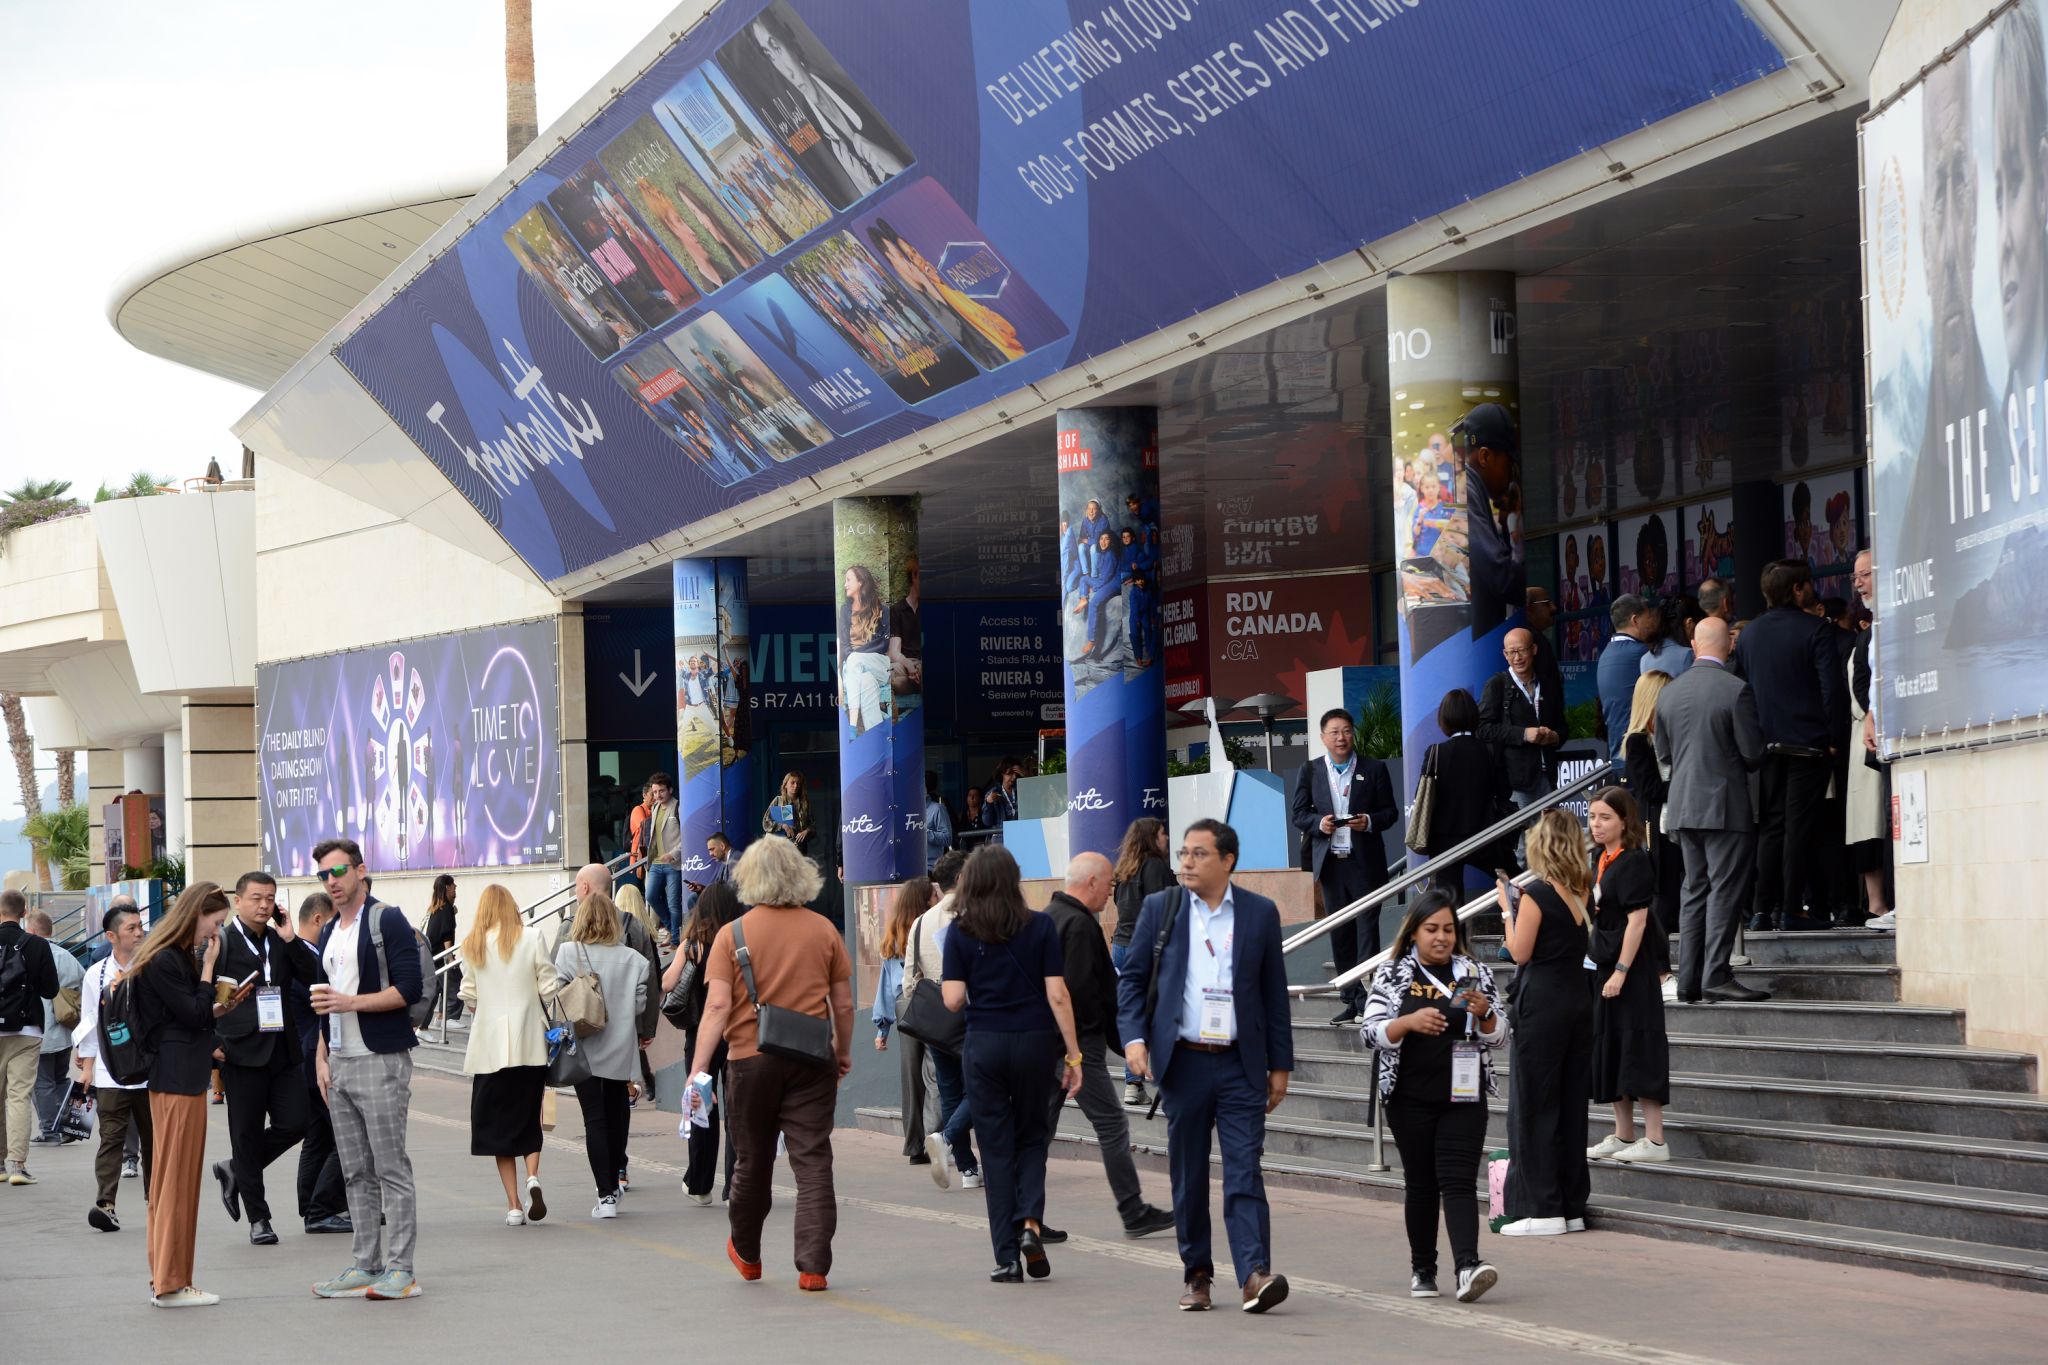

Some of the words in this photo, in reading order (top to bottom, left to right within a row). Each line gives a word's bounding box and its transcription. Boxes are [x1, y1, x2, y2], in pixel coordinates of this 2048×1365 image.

[986, 20, 1122, 126] DELIVERING
[1100, 0, 1200, 52] 11,000
[1017, 154, 1079, 205] 600+
[1062, 93, 1196, 180] FORMATS,
[1166, 42, 1271, 123] SERIES
[1253, 10, 1329, 77] AND
[1310, 0, 1419, 43] FIL
[1388, 328, 1431, 363] no
[808, 367, 872, 411] WHALE
[1065, 433, 1077, 448] OF
[1945, 408, 1991, 525] THE
[2007, 379, 2048, 503] SE
[1182, 598, 1194, 619] BIG
[1226, 590, 1273, 613] RDV
[980, 615, 1020, 626] Access
[1023, 615, 1038, 626] to:
[1226, 612, 1323, 637] CANADA
[980, 636, 1030, 650] RIVIERA
[1034, 635, 1043, 650] 8
[987, 655, 1020, 664] Stands
[1053, 655, 1062, 664] to
[981, 671, 1031, 685] RIVIERA
[1035, 671, 1044, 685] 9
[764, 692, 821, 709] R7.A11
[988, 690, 1027, 699] Seaview
[471, 704, 507, 743] TIME
[266, 732, 281, 752] THE
[282, 730, 302, 751] DAILY
[303, 727, 326, 748] BLIND
[271, 759, 299, 780] DATING
[299, 757, 323, 778] SHOW
[276, 788, 289, 808] ON
[305, 786, 319, 806] TFX
